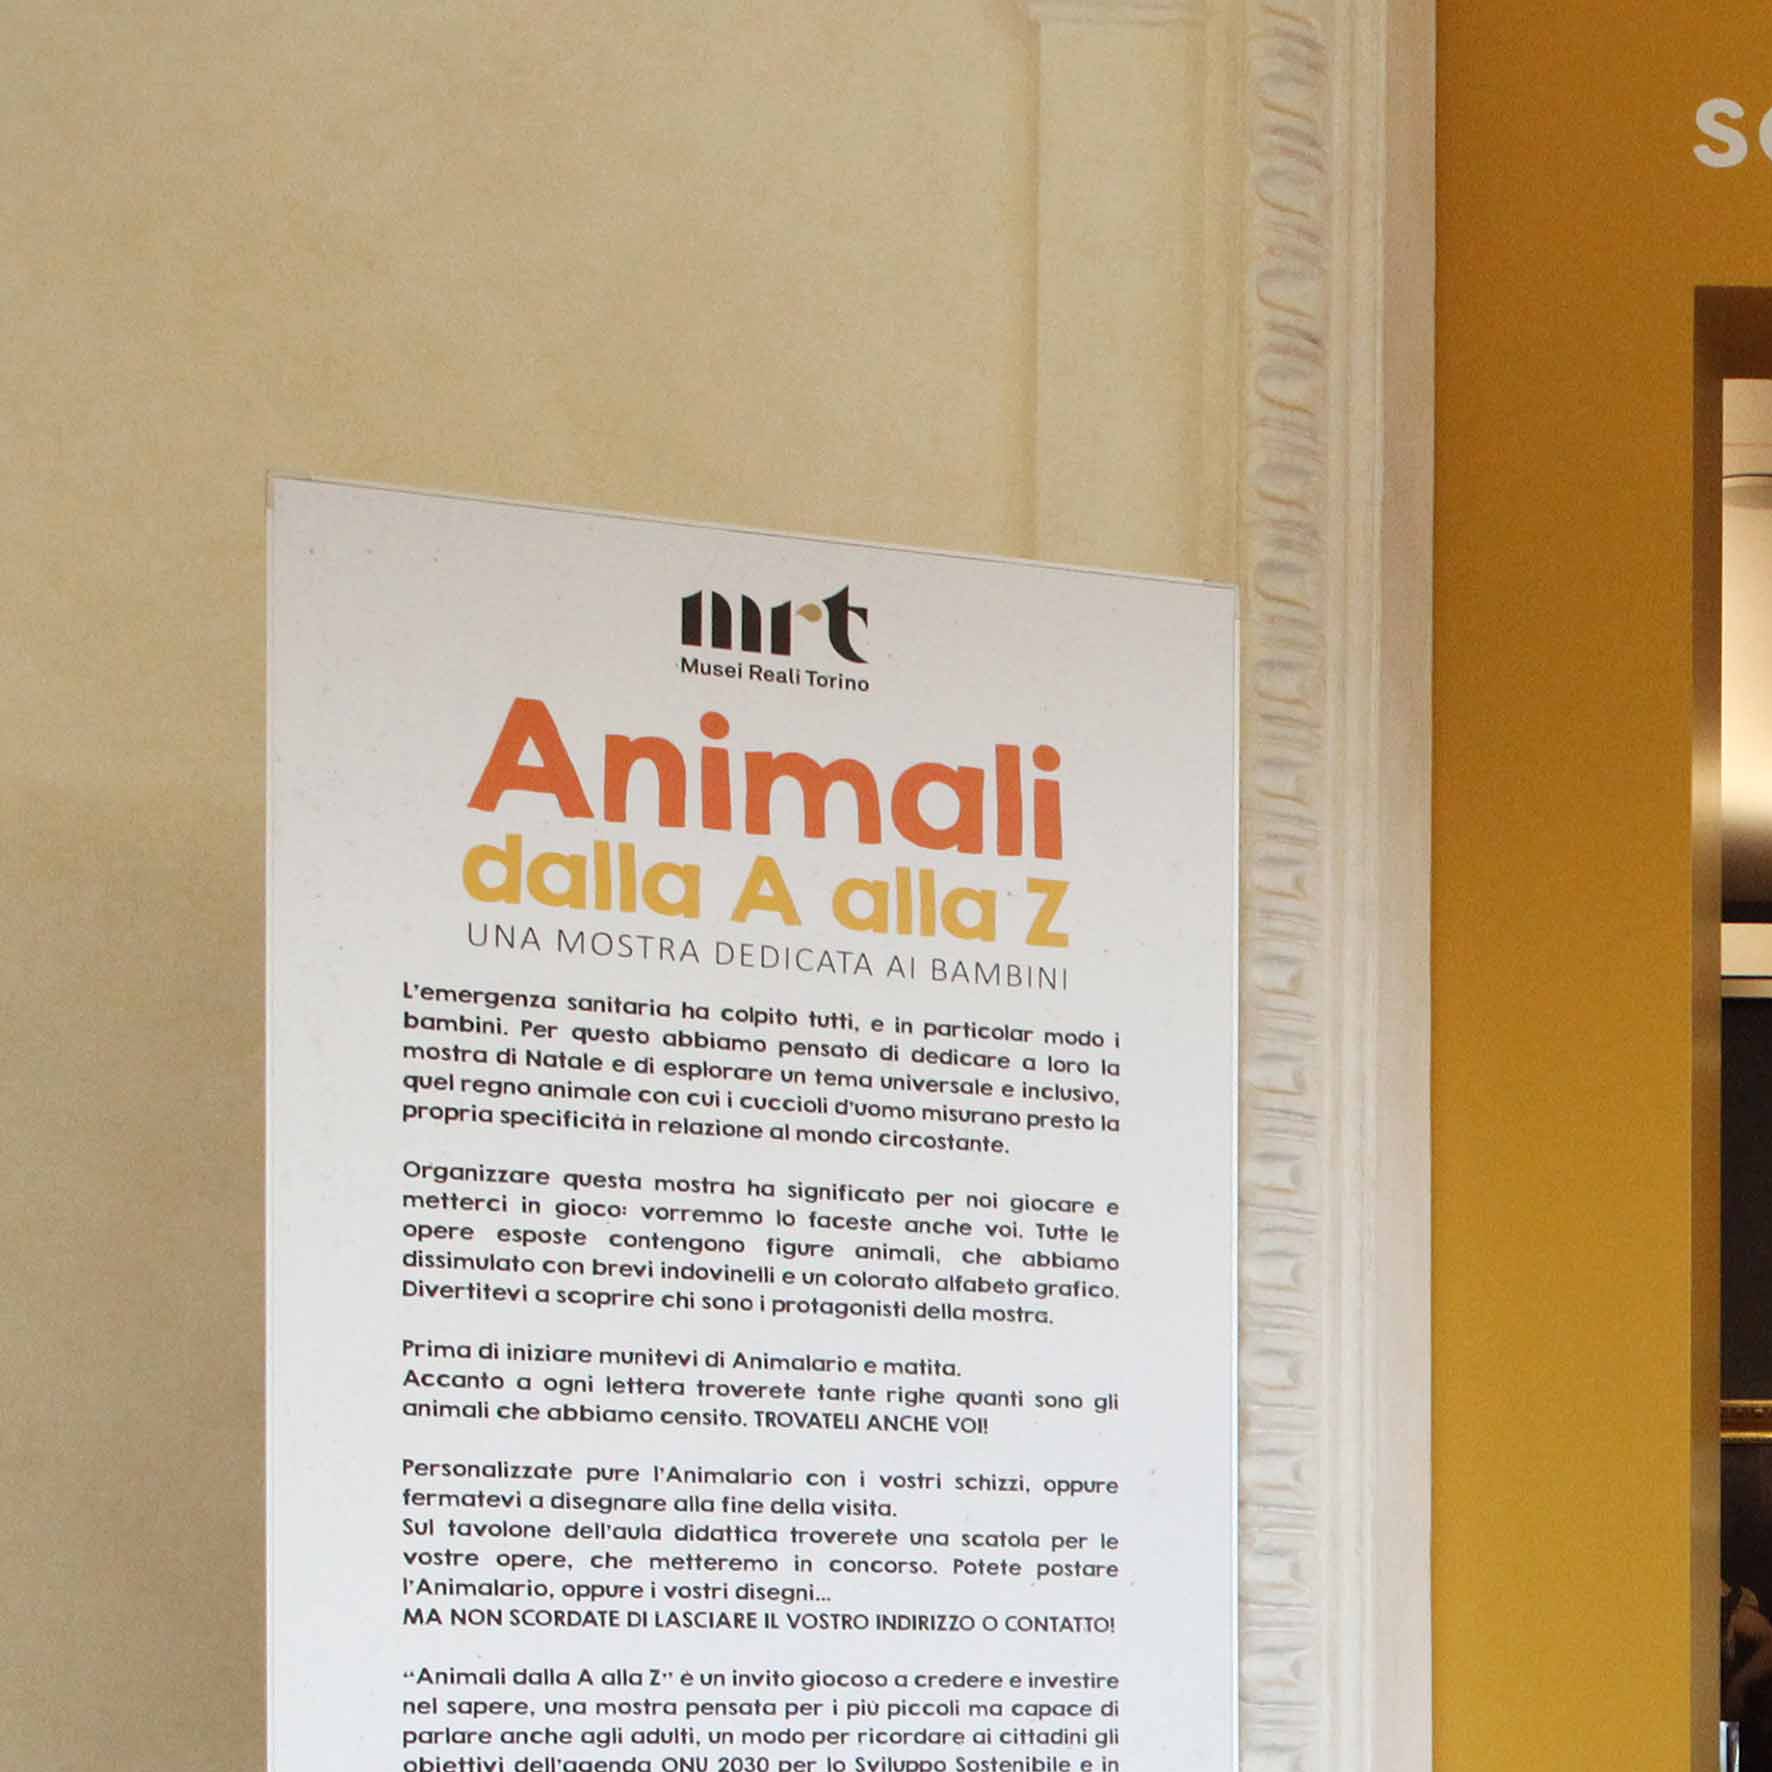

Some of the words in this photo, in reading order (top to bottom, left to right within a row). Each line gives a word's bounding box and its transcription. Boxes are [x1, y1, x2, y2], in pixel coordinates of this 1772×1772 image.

[681, 657, 742, 679] Musei
[749, 664, 800, 685] Reali
[805, 670, 869, 692] Torino
[467, 697, 1062, 860] Animali
[463, 834, 700, 918] dalla
[732, 856, 800, 925] A
[833, 867, 996, 941] alla
[1027, 879, 1068, 947] Z
[468, 922, 541, 951] UNA
[558, 929, 699, 963] MOSTRA
[716, 941, 872, 976] DEDICATA
[886, 955, 914, 979] AI
[932, 958, 1066, 990] BAMBINI
[402, 980, 557, 1010] L'emergenza
[566, 994, 671, 1018] sanitaria
[681, 1000, 710, 1021] ha
[720, 1005, 798, 1029] colpito
[807, 1010, 860, 1033] tutti,
[870, 1018, 885, 1033] e
[894, 1015, 913, 1035] in
[923, 1021, 1035, 1044] particolar
[1043, 1029, 1105, 1048] modo
[1114, 1031, 1121, 1049] i
[403, 1010, 509, 1037] bambini.
[520, 1019, 559, 1039] Per
[571, 1026, 651, 1046] questo
[661, 1029, 767, 1054] abbiamo
[778, 1039, 868, 1060] pensato
[879, 1043, 900, 1063] di
[910, 1045, 1011, 1070] dedicare
[1021, 1056, 1037, 1072] a
[1047, 1055, 1090, 1075] loro
[1100, 1058, 1121, 1078] la
[402, 1160, 551, 1186] Organizzare
[562, 1171, 642, 1192] questa
[654, 1176, 736, 1196] mostra
[747, 1177, 776, 1198] ha
[787, 1180, 905, 1205] significato
[916, 1191, 955, 1210] per
[965, 1191, 998, 1209] noi
[1009, 1193, 1095, 1215] giocare
[1105, 1201, 1120, 1216] e
[402, 1223, 475, 1243] opere
[496, 1227, 588, 1248] esposte
[608, 1231, 746, 1256] contengono
[765, 1236, 835, 1260] figure
[854, 1242, 941, 1265] animali,
[961, 1247, 1003, 1266] che
[1021, 1250, 1120, 1272] abbiamo
[402, 1338, 472, 1360] Prima
[477, 1341, 500, 1361] di
[506, 1341, 593, 1364] iniziare
[599, 1347, 699, 1368] munitevi
[704, 1350, 726, 1369] di
[731, 1351, 858, 1374] Animalario
[863, 1359, 878, 1375] e
[882, 1357, 962, 1377] matita.
[401, 1399, 490, 1419] animali
[496, 1401, 541, 1421] che
[546, 1403, 654, 1424] abbiamo
[659, 1407, 748, 1428] censito.
[753, 1409, 860, 1431] TROVATELI
[866, 1413, 940, 1433] ANCHE
[945, 1416, 989, 1435] VOI!
[401, 1487, 522, 1509] fermatevi
[528, 1494, 544, 1510] a
[550, 1491, 668, 1515] disegnare
[673, 1494, 715, 1513] alla
[720, 1495, 765, 1515] fine
[770, 1496, 825, 1516] della
[831, 1498, 897, 1518] visita.
[402, 1607, 444, 1626] MA
[450, 1607, 503, 1627] NON
[509, 1608, 621, 1628] SCORDATE
[626, 1610, 648, 1629] DI
[654, 1610, 758, 1630] LASCIARE
[763, 1611, 780, 1630] IL
[785, 1612, 870, 1631] VOSTRO
[875, 1613, 976, 1632] INDIRIZZO
[981, 1615, 999, 1632] O
[1004, 1615, 1116, 1634] CONTATTO!
[402, 1726, 493, 1749] parlare
[499, 1726, 574, 1745] anche
[580, 1726, 624, 1750] agli
[630, 1726, 701, 1748] adulti,
[707, 1730, 734, 1745] un
[741, 1727, 806, 1745] modo
[811, 1730, 851, 1750] per
[857, 1727, 966, 1746] ricordare
[972, 1727, 992, 1745] ai
[998, 1727, 1088, 1746] cittadini
[1094, 1727, 1120, 1750] gli
